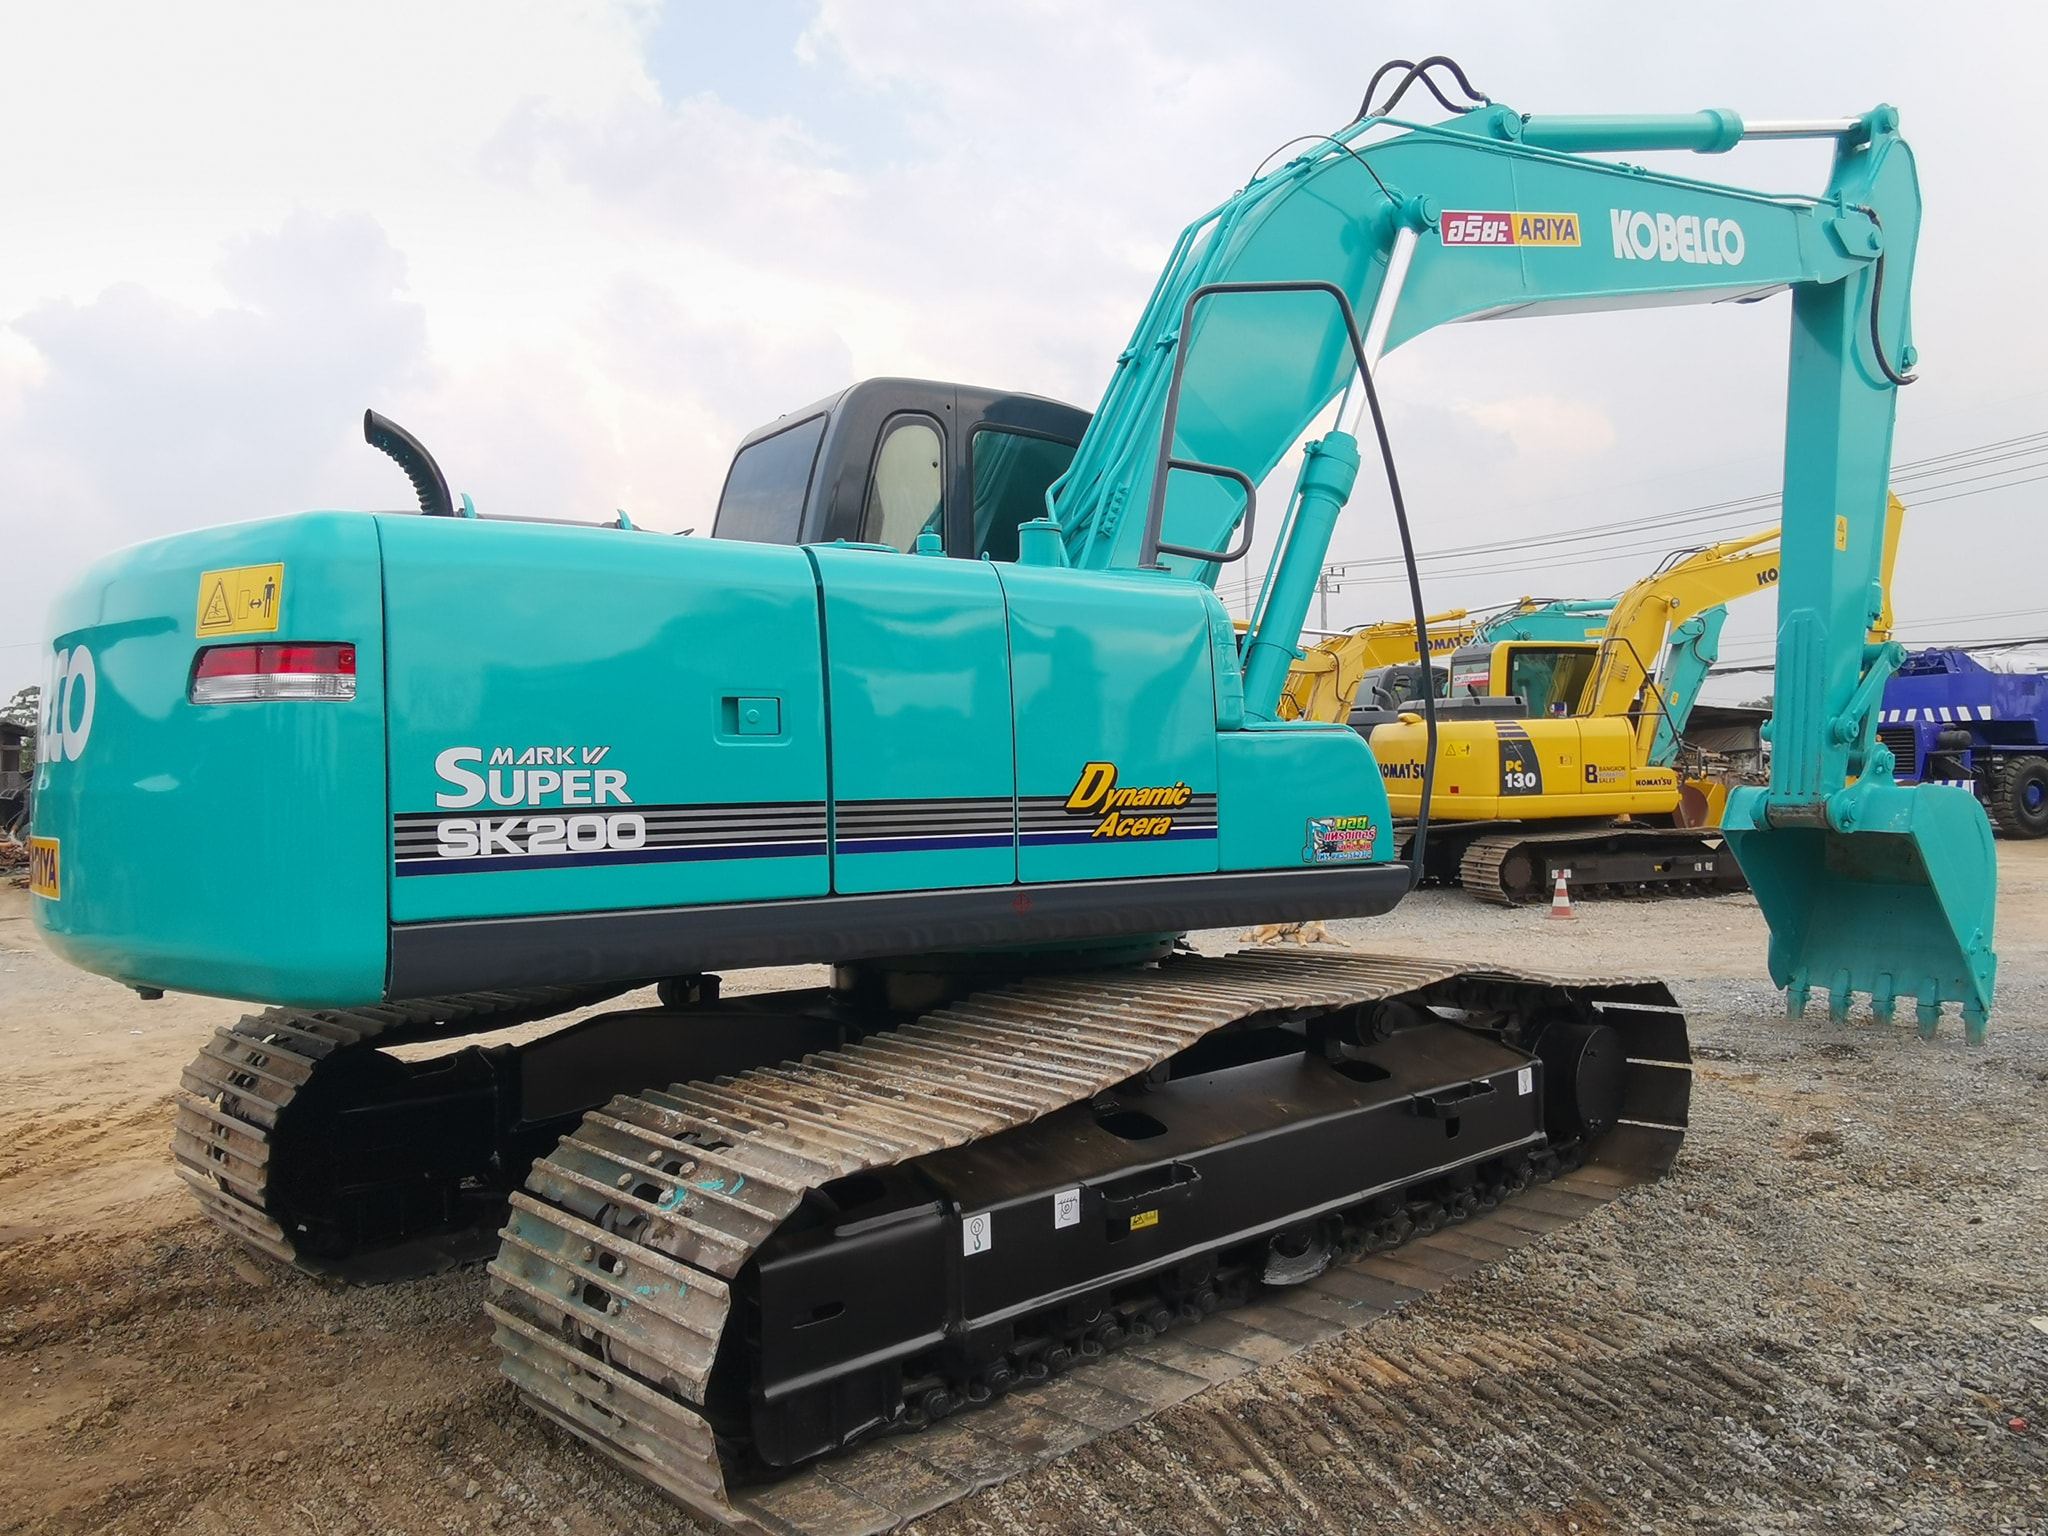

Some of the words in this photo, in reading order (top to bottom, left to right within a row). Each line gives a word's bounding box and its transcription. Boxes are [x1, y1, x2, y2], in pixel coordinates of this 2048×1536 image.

[1447, 215, 1509, 242] อริยะ
[1519, 217, 1577, 241] ARIYA
[1609, 208, 1746, 266] KOBELCO
[1756, 567, 1779, 586] KO
[488, 746, 576, 766] MARK
[1505, 760, 1523, 772] PC
[434, 746, 635, 809] SUPER
[1504, 772, 1537, 788] 130
[1585, 763, 1598, 783] B
[1635, 777, 1673, 786] KOMATSU
[1065, 762, 1192, 815] Dynamic
[437, 814, 646, 858] SK200
[1092, 812, 1173, 838] Acera
